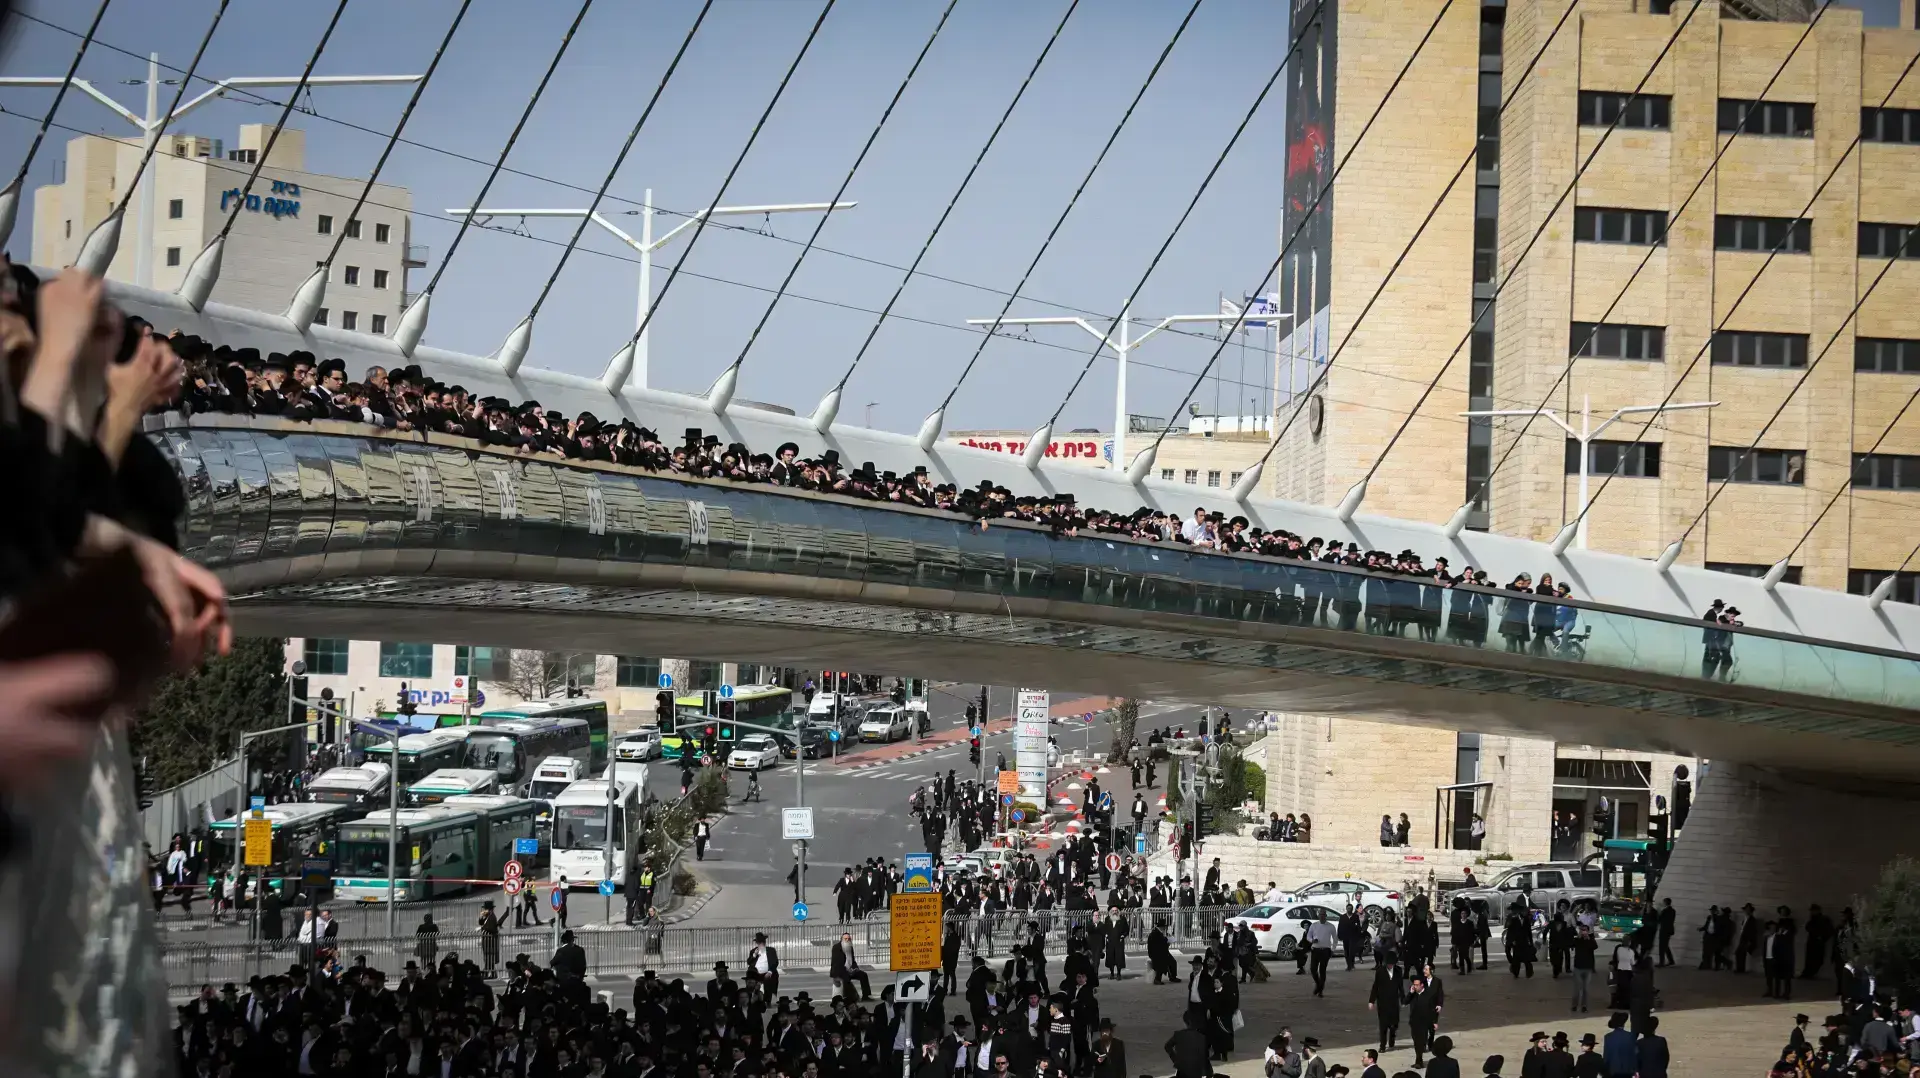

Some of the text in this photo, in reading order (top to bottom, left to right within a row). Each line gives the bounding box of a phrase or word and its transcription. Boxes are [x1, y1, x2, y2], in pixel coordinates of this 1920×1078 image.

[271, 180, 300, 197] בית
[1062, 441, 1097, 458] בית
[692, 509, 707, 535] 6.9
[432, 690, 450, 707] נק
